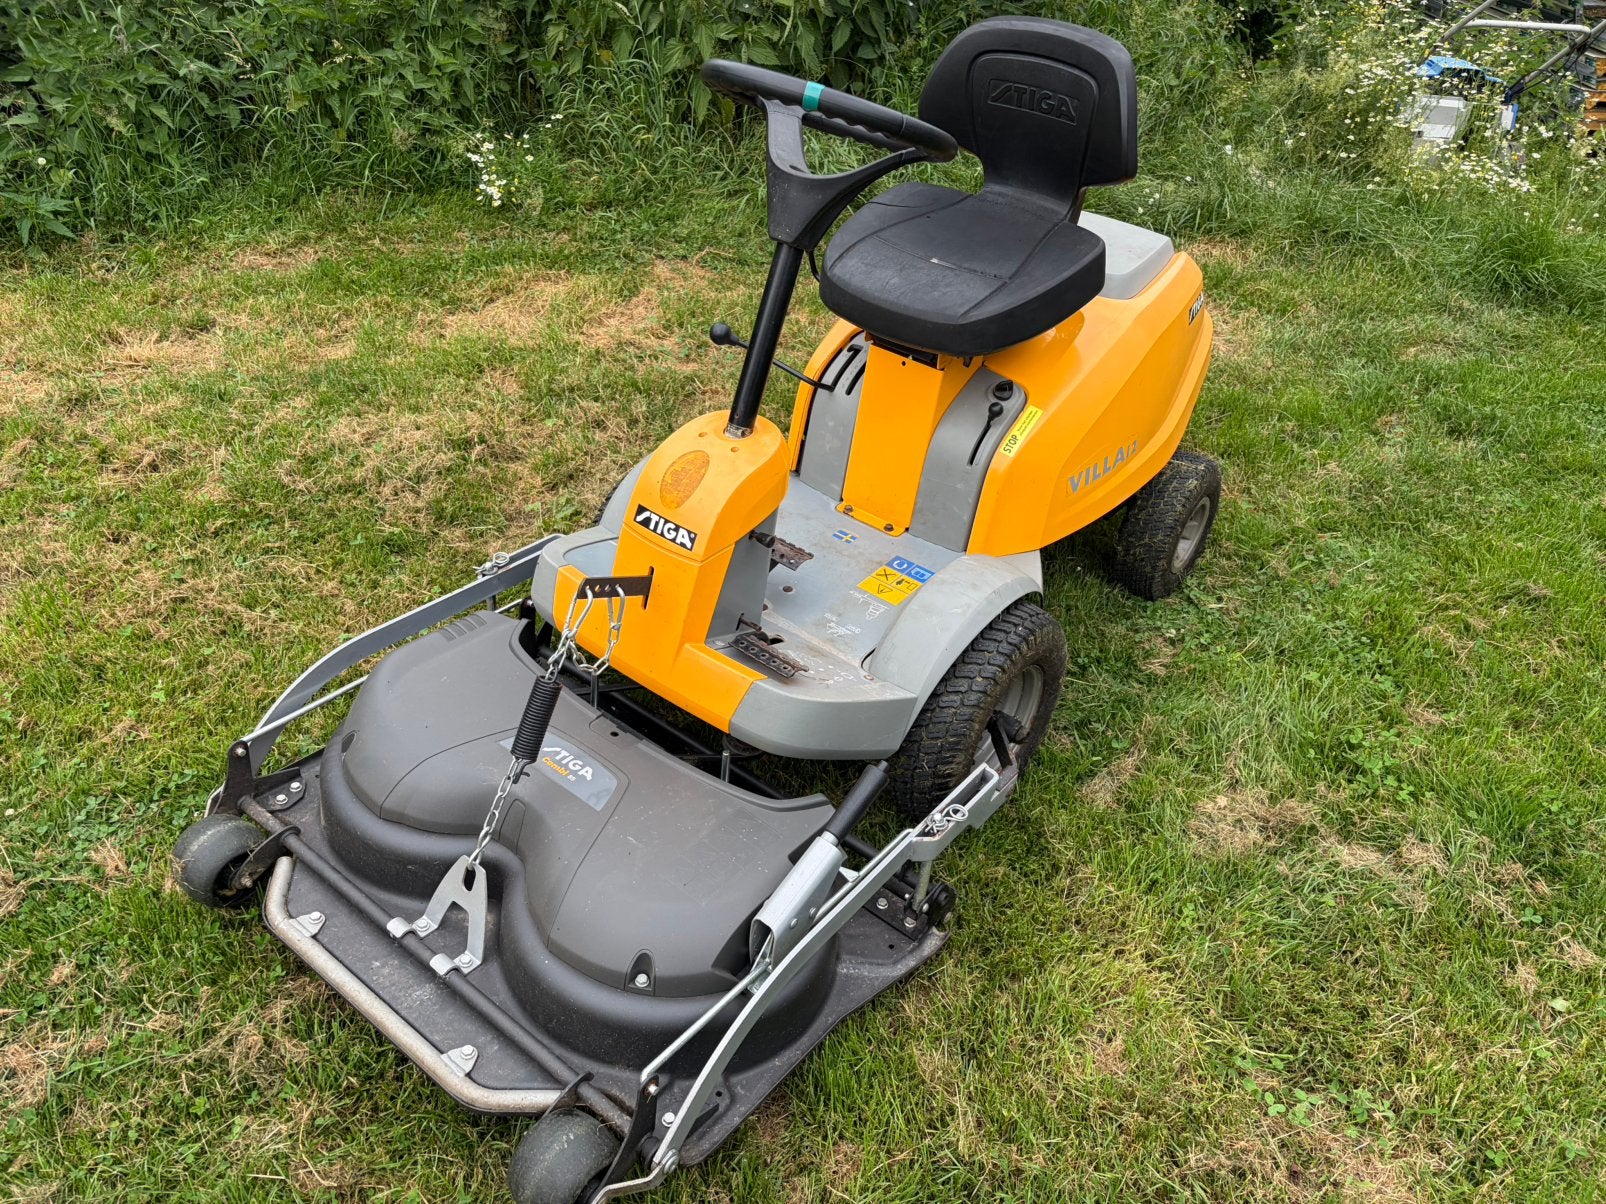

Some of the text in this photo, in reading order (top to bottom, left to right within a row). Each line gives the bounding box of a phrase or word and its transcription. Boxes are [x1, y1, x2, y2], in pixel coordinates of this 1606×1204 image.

[988, 83, 1077, 125] STIGA
[1003, 435, 1019, 454] STOP
[1069, 446, 1125, 493] VILLA
[636, 511, 694, 549] STIGA
[542, 747, 593, 781] STIGA
